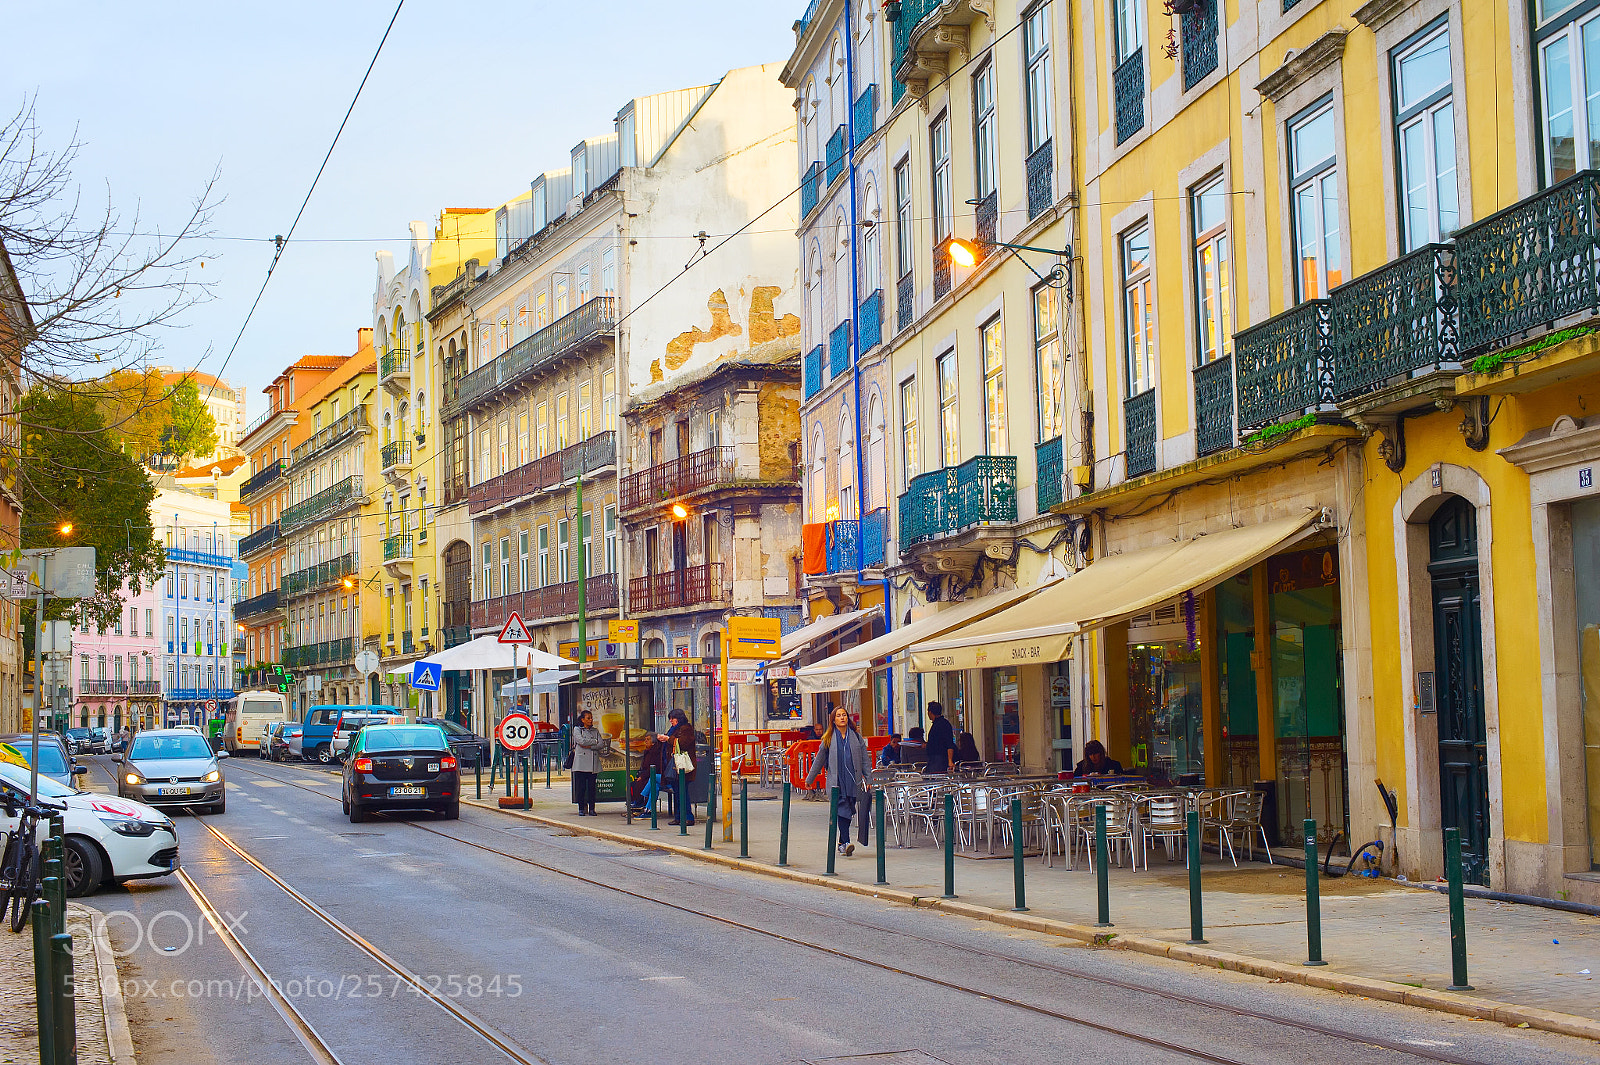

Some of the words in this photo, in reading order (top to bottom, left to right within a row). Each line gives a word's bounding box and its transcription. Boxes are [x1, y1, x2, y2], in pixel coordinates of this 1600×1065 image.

[1030, 646, 1041, 658] BAR
[780, 687, 793, 695] ELA
[506, 725, 529, 739] 30
[394, 786, 402, 794] 23
